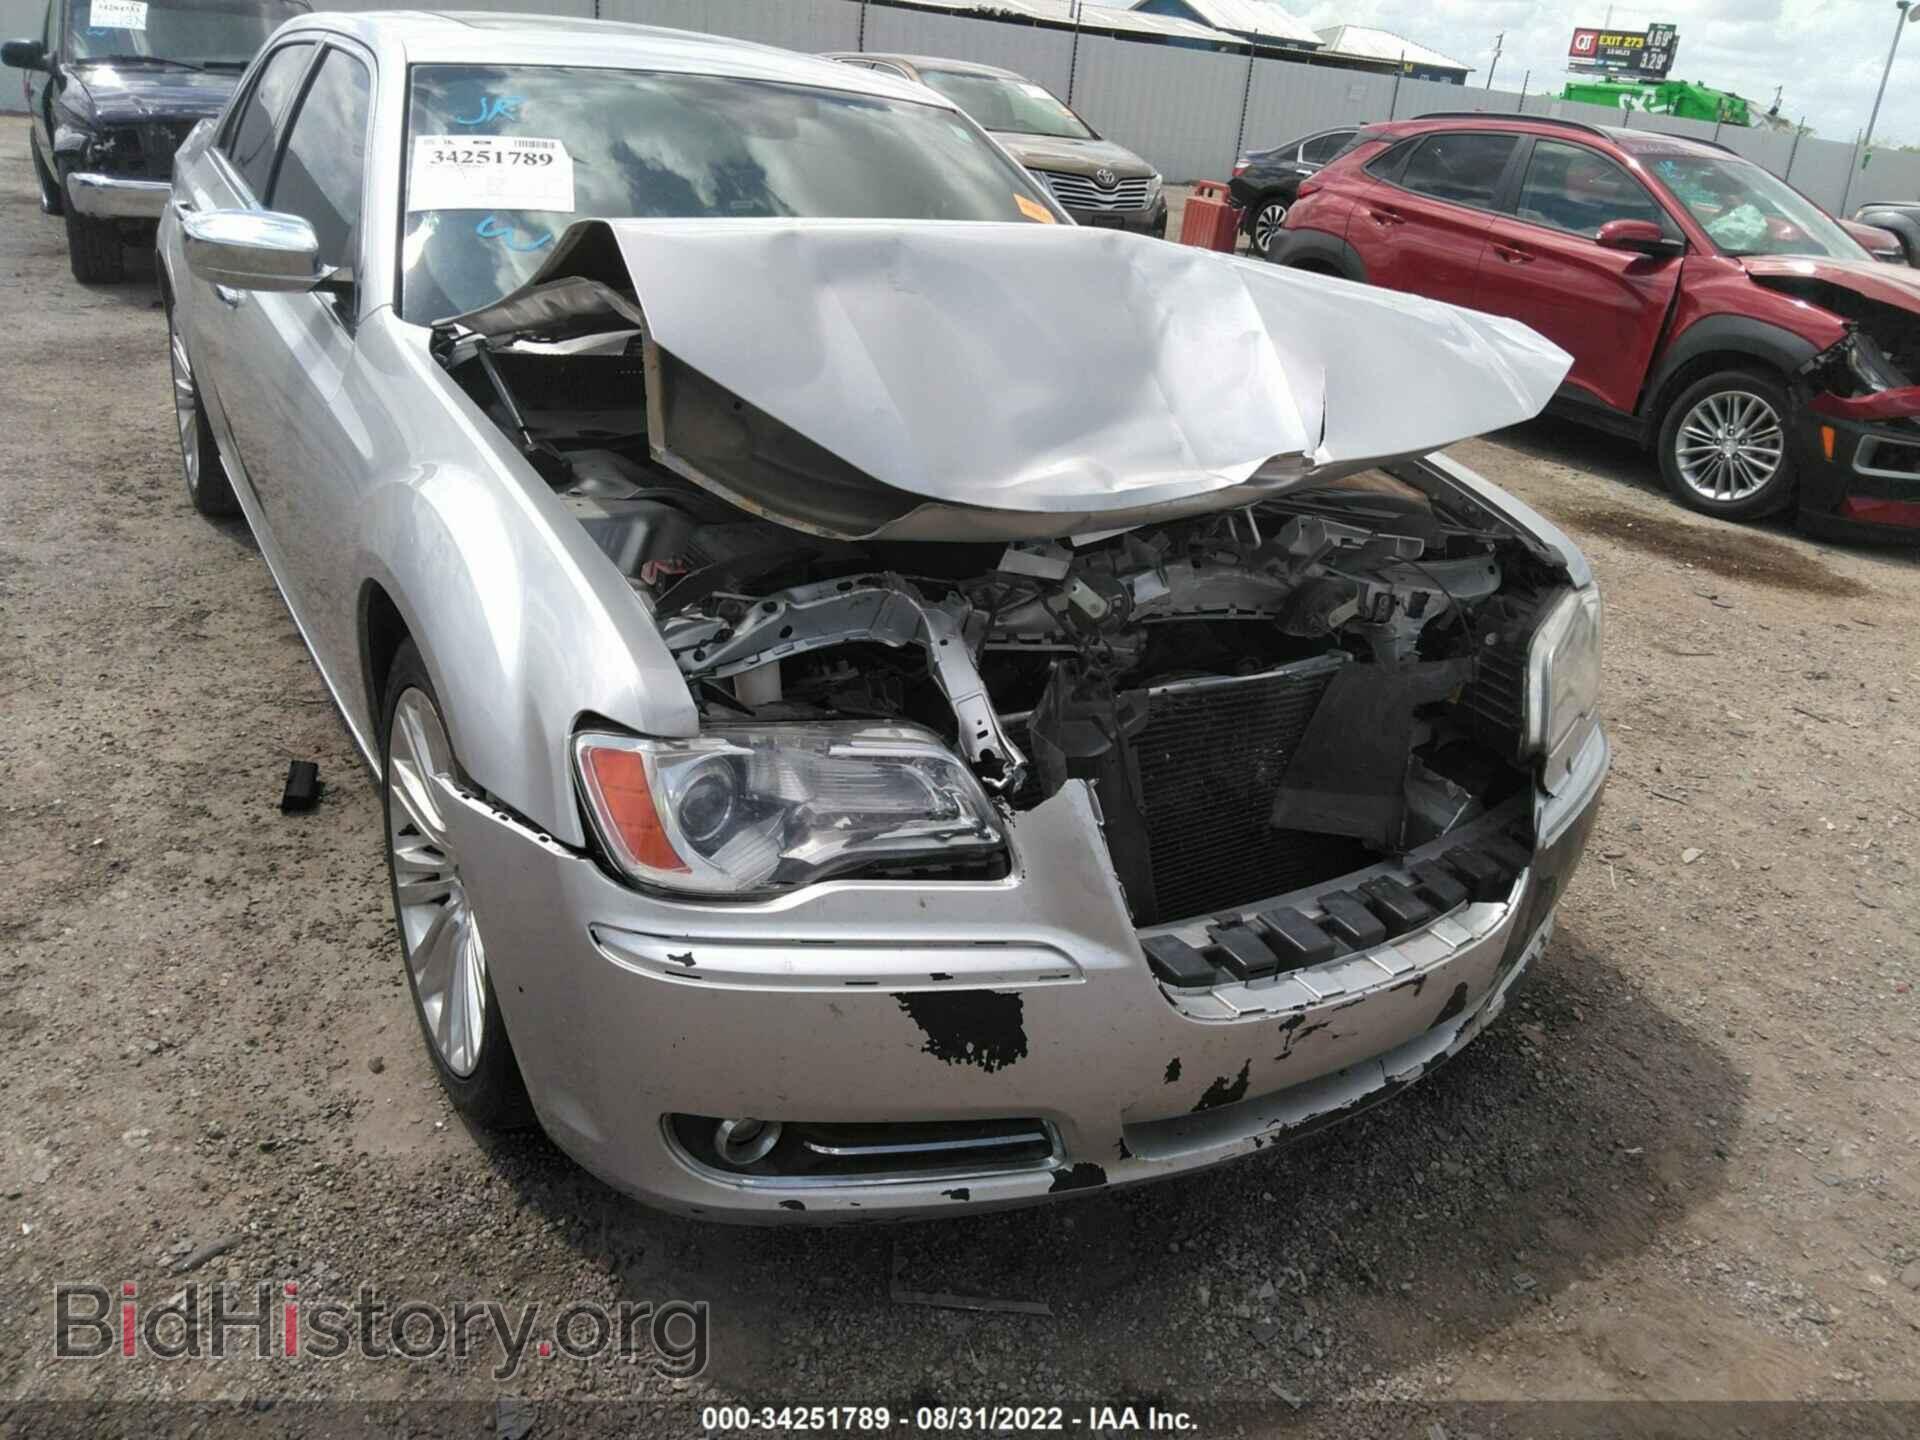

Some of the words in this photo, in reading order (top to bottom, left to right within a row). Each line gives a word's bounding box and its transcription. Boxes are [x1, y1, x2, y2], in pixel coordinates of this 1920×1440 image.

[1598, 35, 1622, 45] EXIT
[1623, 36, 1645, 48] 273
[429, 149, 554, 167] 34251789
